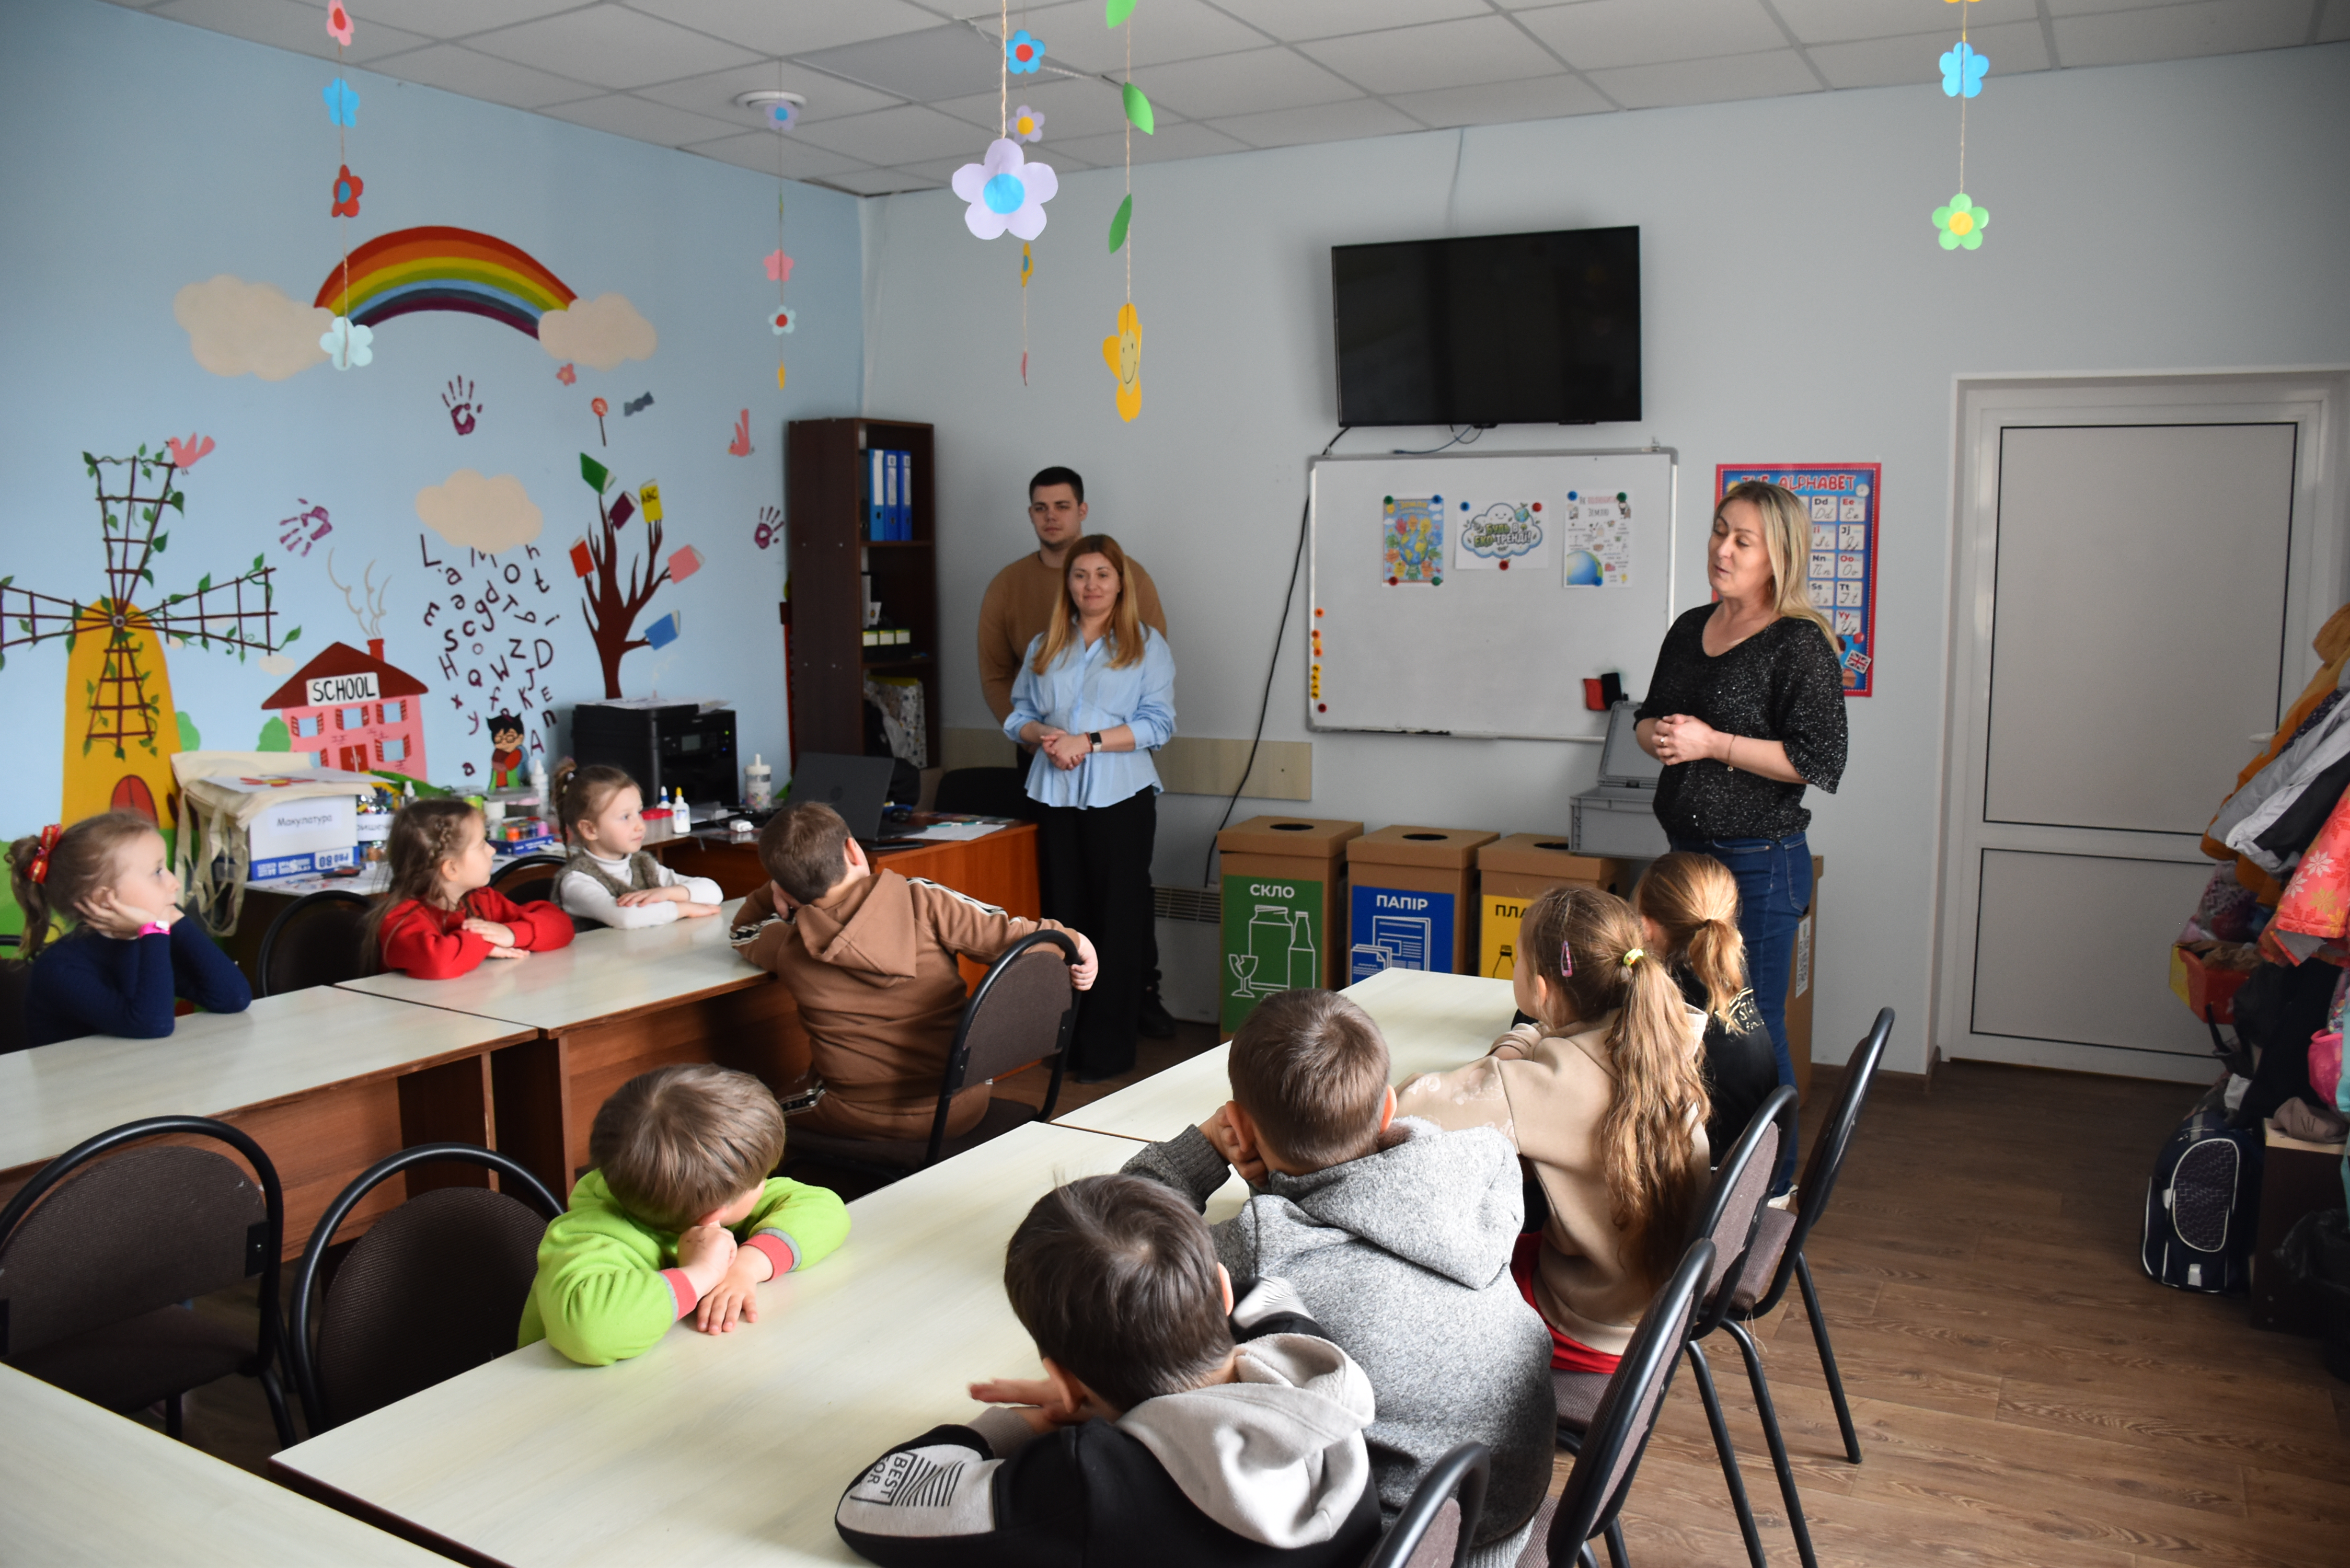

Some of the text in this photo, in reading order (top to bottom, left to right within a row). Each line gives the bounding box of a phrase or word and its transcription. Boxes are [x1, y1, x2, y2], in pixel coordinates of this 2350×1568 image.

[1778, 475, 1856, 490] ALPHABET
[1841, 526, 1850, 536] Jj
[420, 534, 442, 568] L
[486, 580, 500, 604] d
[534, 568, 550, 594] t
[1838, 612, 1850, 621] Yy
[438, 652, 458, 681] H
[534, 638, 554, 670] D
[313, 676, 376, 702] SCHOOL
[541, 686, 553, 702] E
[531, 729, 545, 756] A
[1249, 883, 1295, 899] СКЛО
[1376, 894, 1429, 911] ПАПІР
[881, 1456, 909, 1498] BEST
